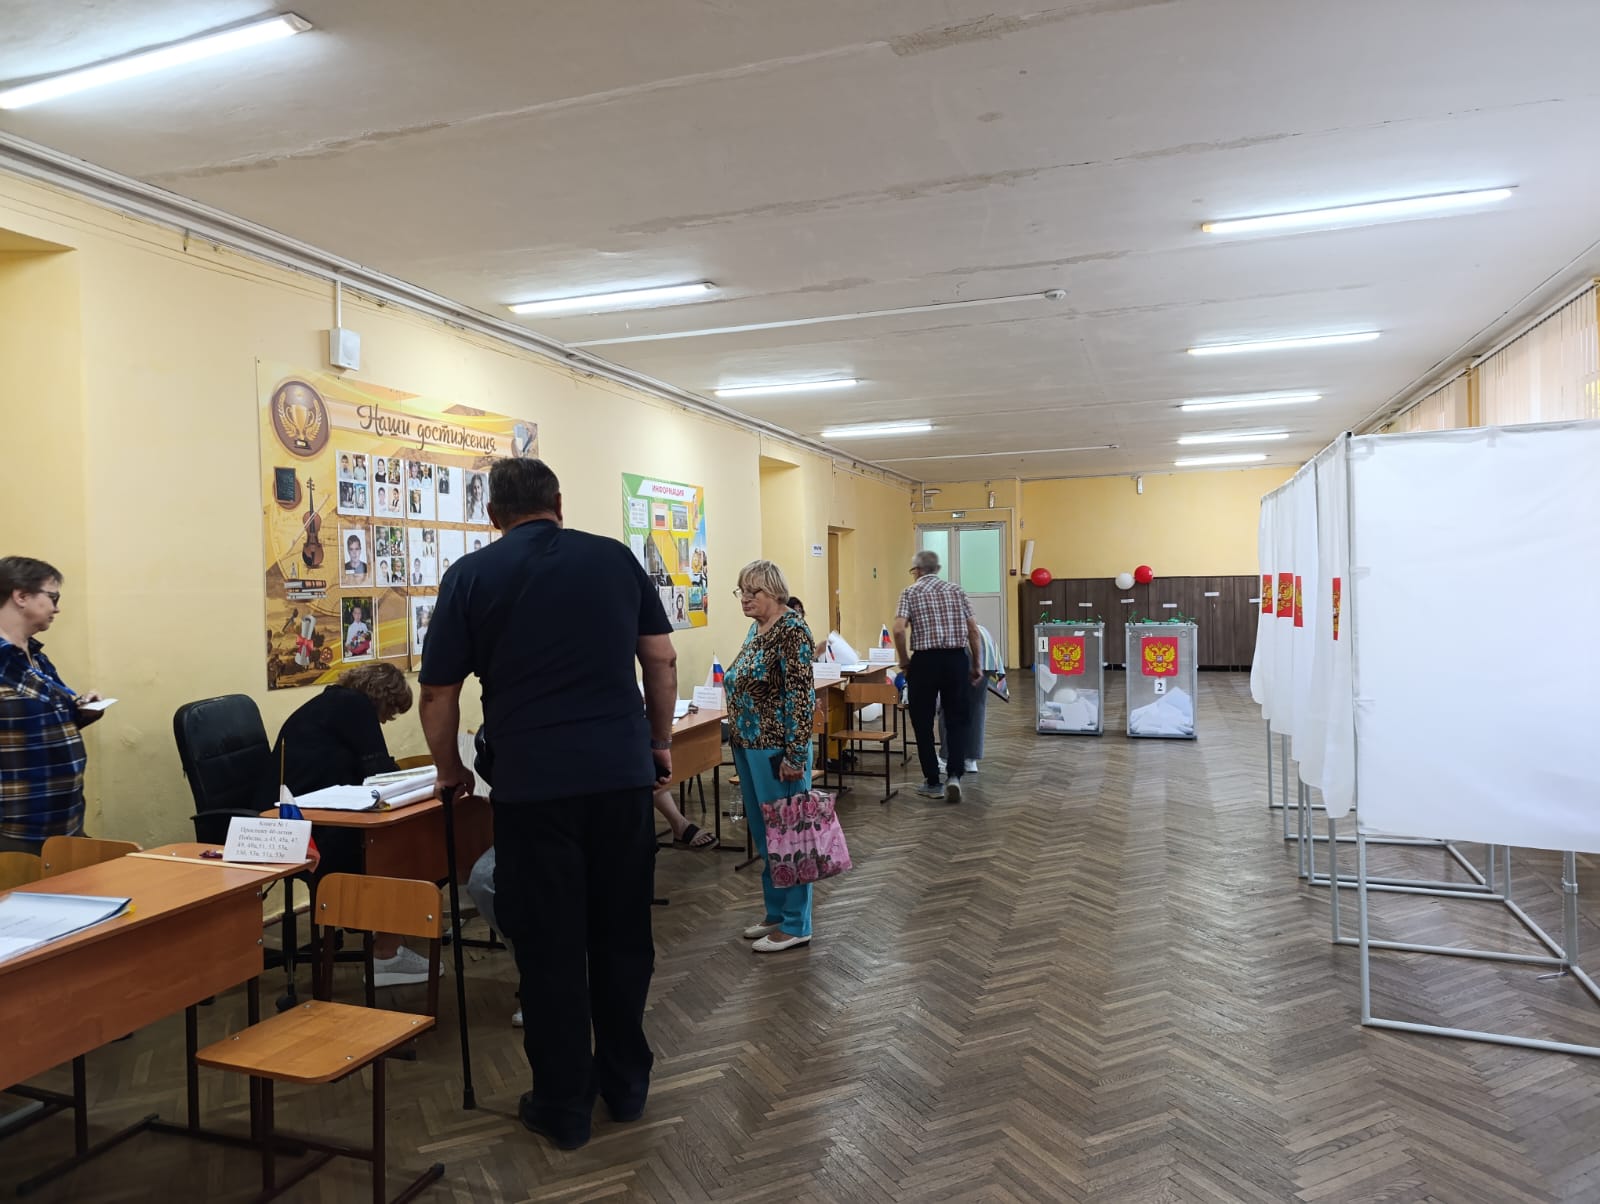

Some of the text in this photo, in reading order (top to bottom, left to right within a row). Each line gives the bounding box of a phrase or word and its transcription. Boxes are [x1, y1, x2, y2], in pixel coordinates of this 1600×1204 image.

[356, 403, 497, 455] Наши достижения
[651, 484, 685, 497] ИНФОРМАЦИЯ
[1156, 681, 1163, 692] 2
